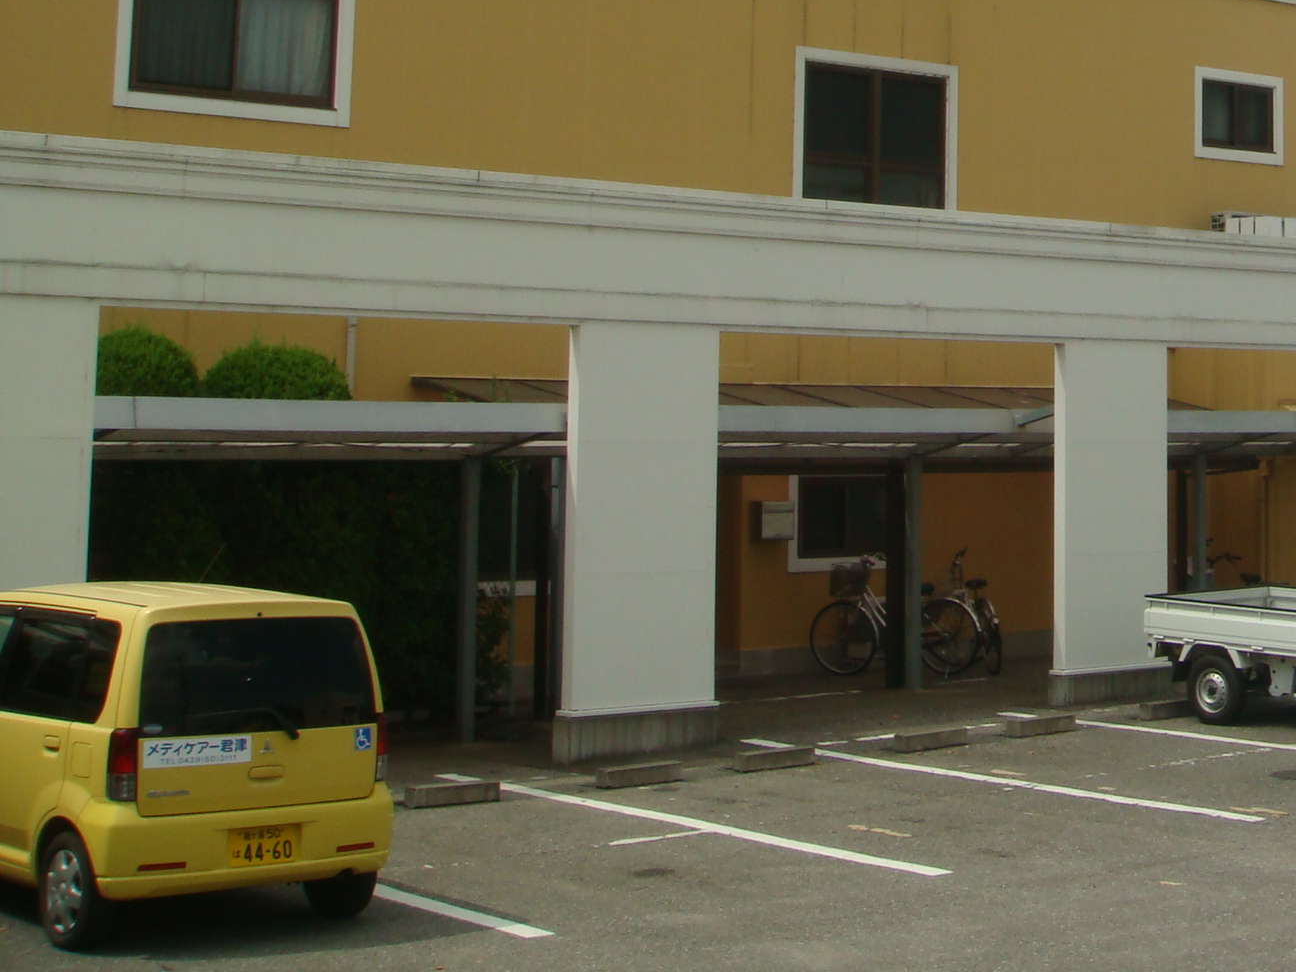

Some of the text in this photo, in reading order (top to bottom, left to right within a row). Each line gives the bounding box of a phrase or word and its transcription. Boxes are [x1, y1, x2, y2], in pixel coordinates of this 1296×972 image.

[147, 738, 247, 756] メディケアー君津
[243, 839, 293, 862] 44-60
